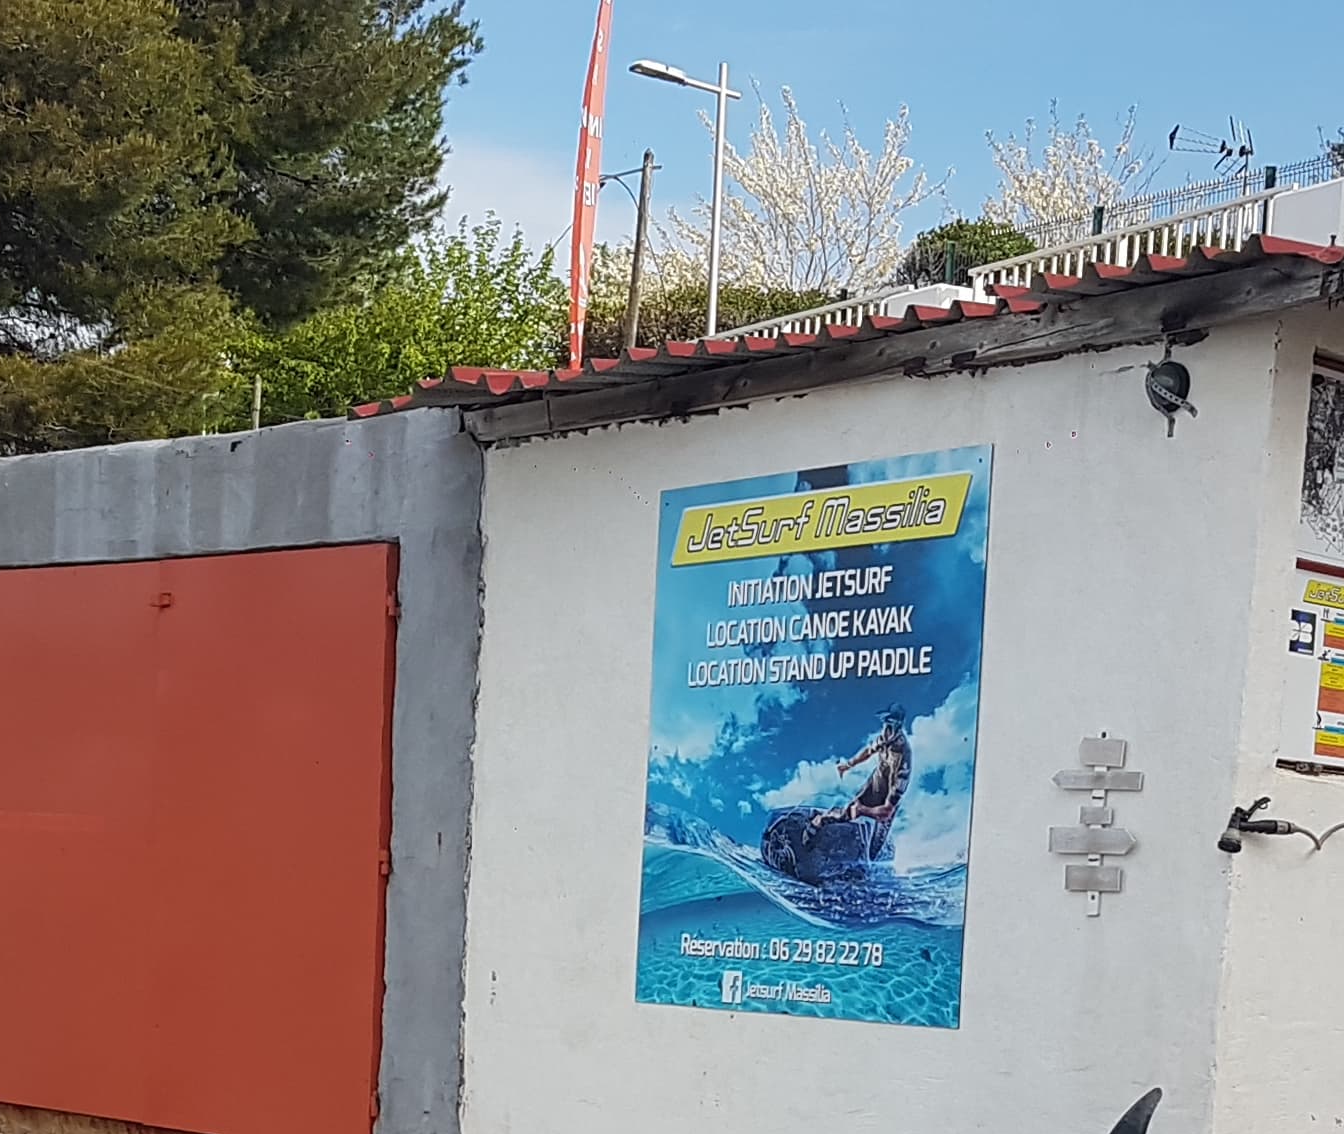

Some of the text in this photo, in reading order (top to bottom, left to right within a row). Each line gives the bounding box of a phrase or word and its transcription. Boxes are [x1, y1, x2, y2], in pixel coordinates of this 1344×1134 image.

[687, 485, 947, 553] JetSurf Massilia
[727, 565, 894, 608] INITIATION JETSURF
[706, 604, 914, 649] LOCATION CANOE KAYAK
[687, 646, 934, 688] LOCATION STAND UP PADDLE
[680, 932, 760, 960] Réservation
[769, 937, 790, 962] 06
[792, 938, 812, 963] 29
[815, 940, 837, 964] 82
[839, 941, 859, 966] 22
[861, 942, 884, 968] 78
[744, 980, 785, 1001] Jetsurf
[787, 982, 832, 1004] Massilia
